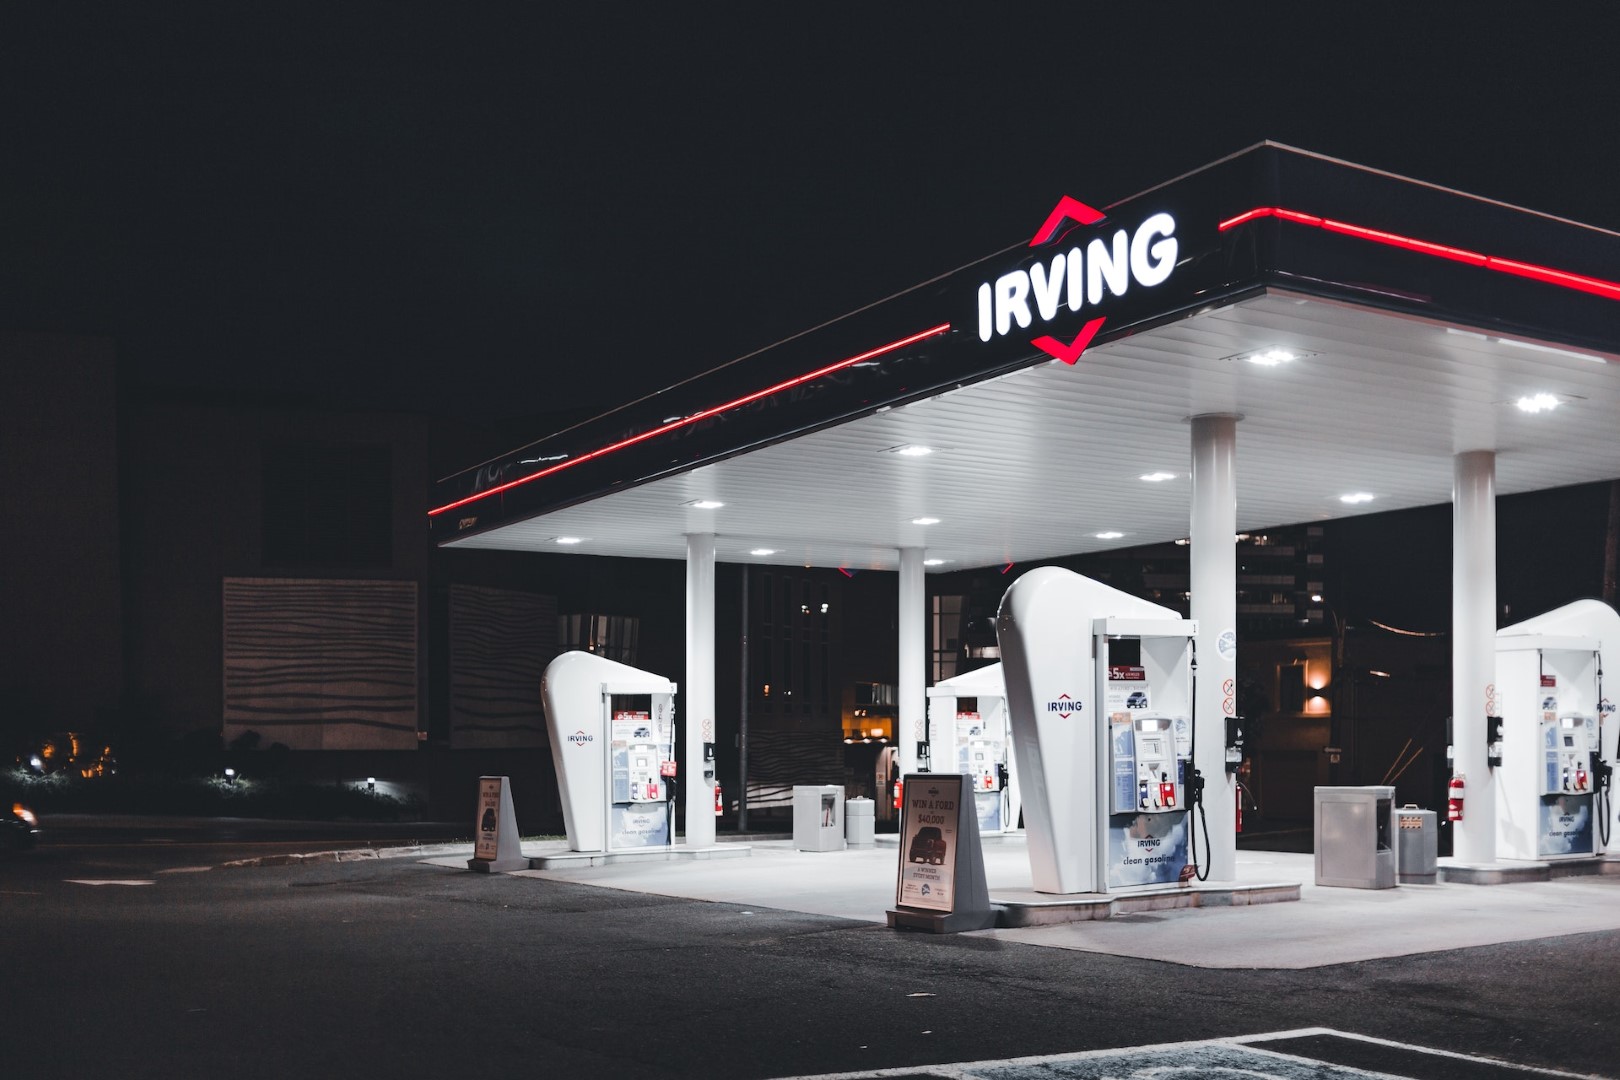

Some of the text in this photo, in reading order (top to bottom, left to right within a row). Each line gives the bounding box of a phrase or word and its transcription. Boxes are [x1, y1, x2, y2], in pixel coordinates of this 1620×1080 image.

[978, 212, 1179, 342] IRVING
[1047, 701, 1083, 712] IRVING
[567, 734, 594, 742] IRVING
[912, 800, 954, 810] WIN A FORD
[918, 814, 945, 825] $40,000
[1559, 815, 1575, 823] IRVING
[1137, 839, 1162, 848] IRVING
[1122, 853, 1175, 866] clean gasoline
